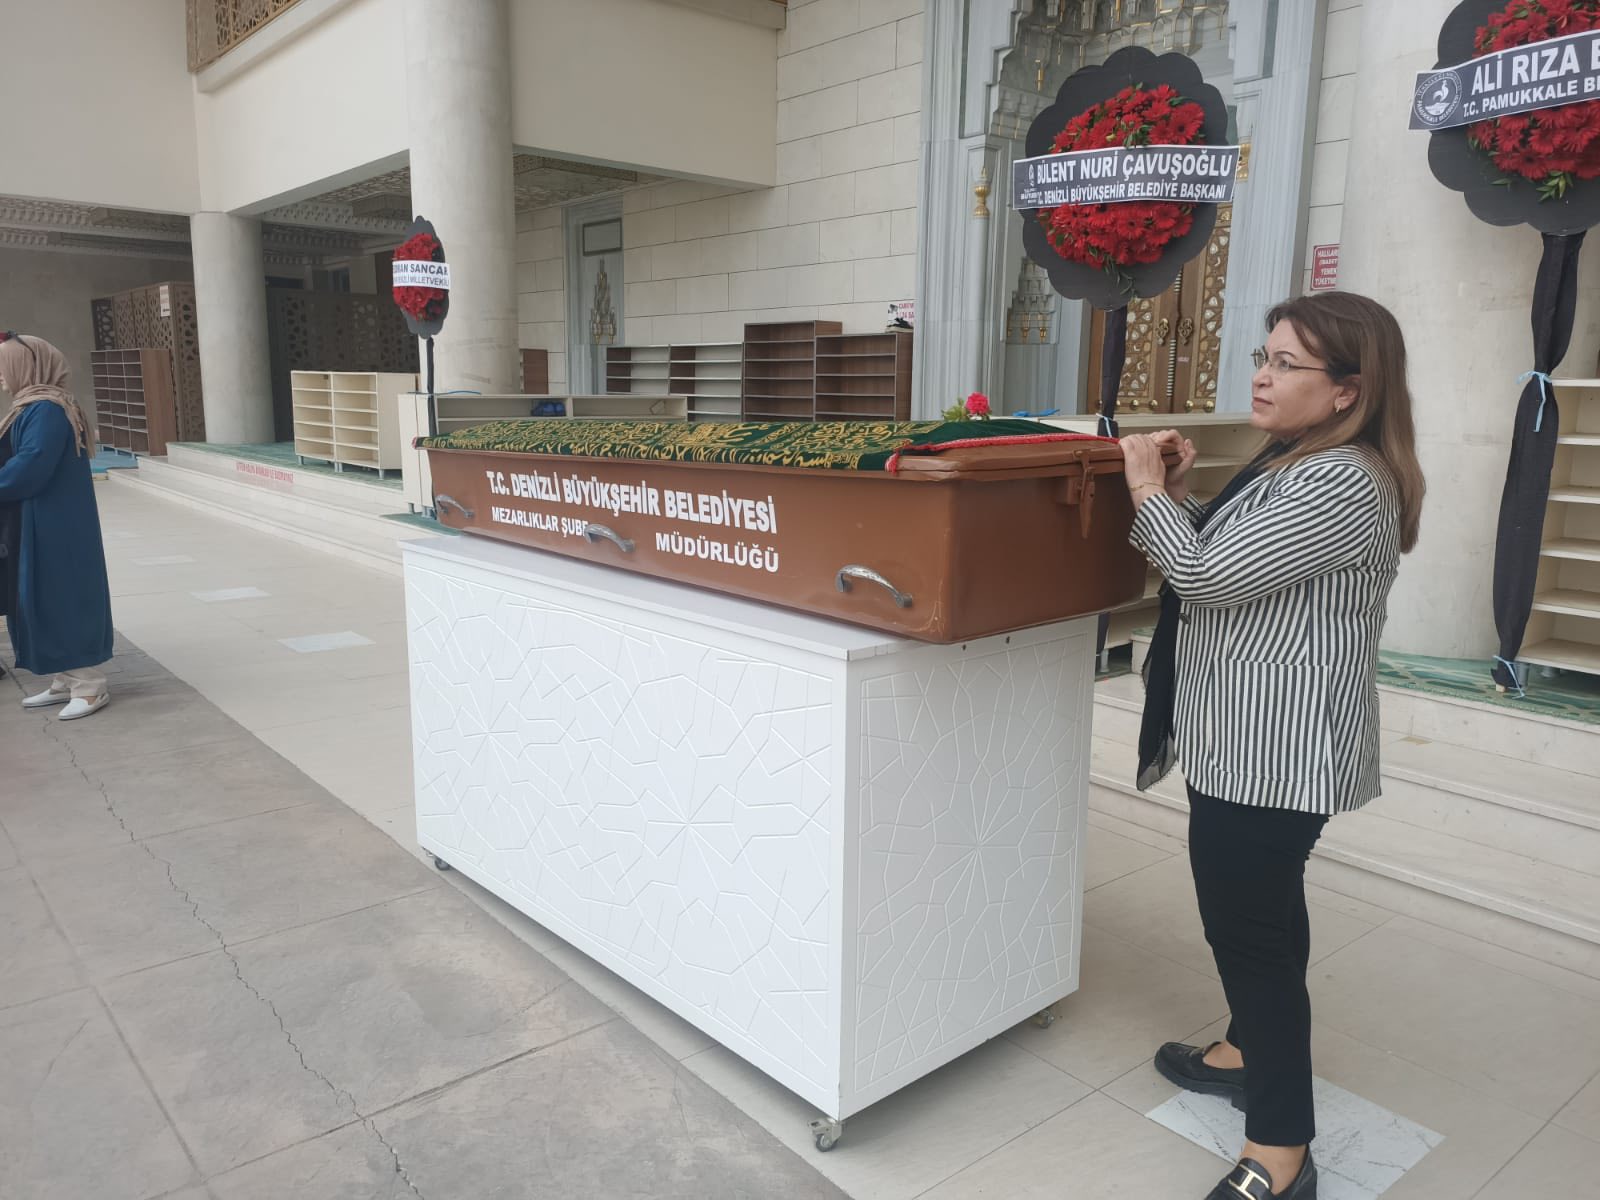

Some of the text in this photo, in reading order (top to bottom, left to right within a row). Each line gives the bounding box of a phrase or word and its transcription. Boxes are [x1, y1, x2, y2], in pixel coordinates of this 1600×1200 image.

[1471, 52, 1503, 96] ALİ
[1511, 44, 1580, 86] RIZA
[1463, 101, 1479, 117] T.C.
[1482, 79, 1578, 112] PAMUKKALE
[1037, 148, 1233, 185] BÜLENT NURİ ÇAVUŞOĞLU
[1070, 184, 1125, 202] BÜYÜKŞEHİR
[1127, 181, 1179, 198] BELEDİYE
[1180, 182, 1227, 200] BAŞKANI
[486, 469, 777, 534] T.C. DENİZLİ BÜYÜKŞEHİR BELEDİYESİ
[491, 506, 559, 533] MEZARLIKLAR
[655, 530, 779, 573] MÜDÜRLÜĞÜ
